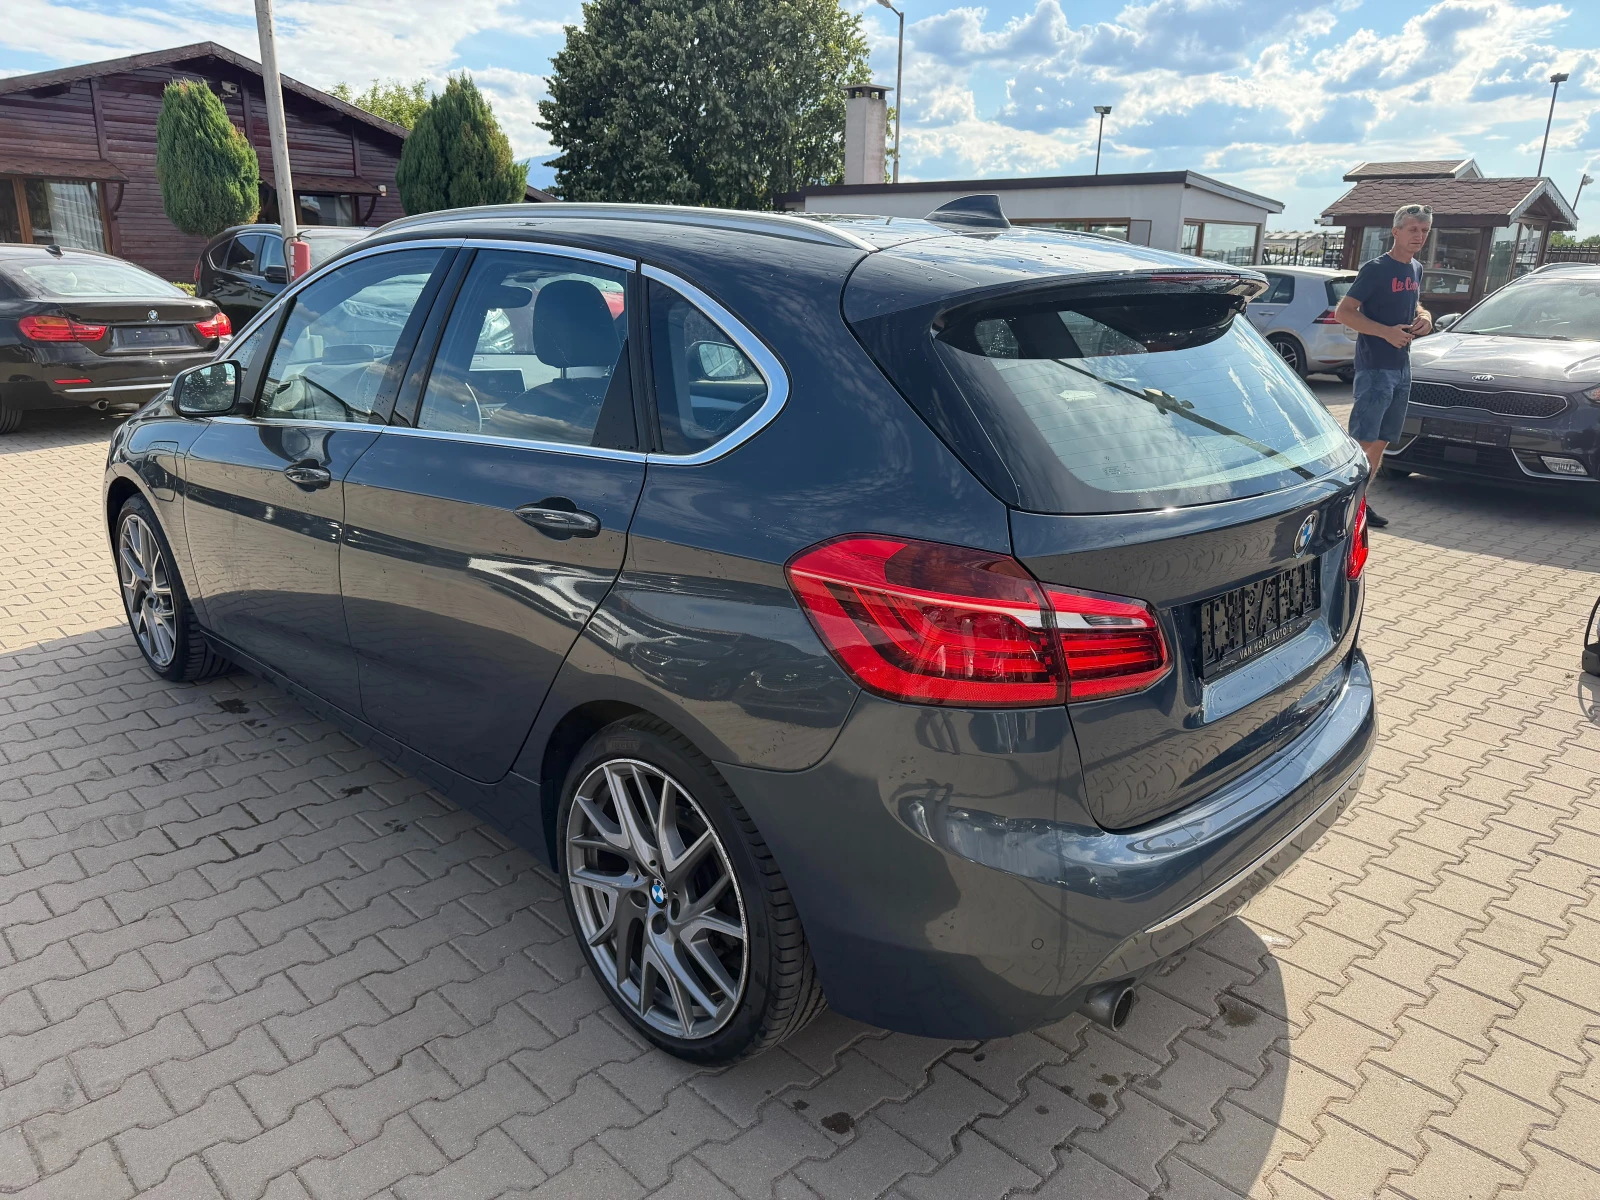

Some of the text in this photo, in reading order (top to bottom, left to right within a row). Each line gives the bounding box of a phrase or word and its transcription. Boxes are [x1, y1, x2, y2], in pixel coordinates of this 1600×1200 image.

[1240, 624, 1292, 659] VAN HOUT AUTO'S
